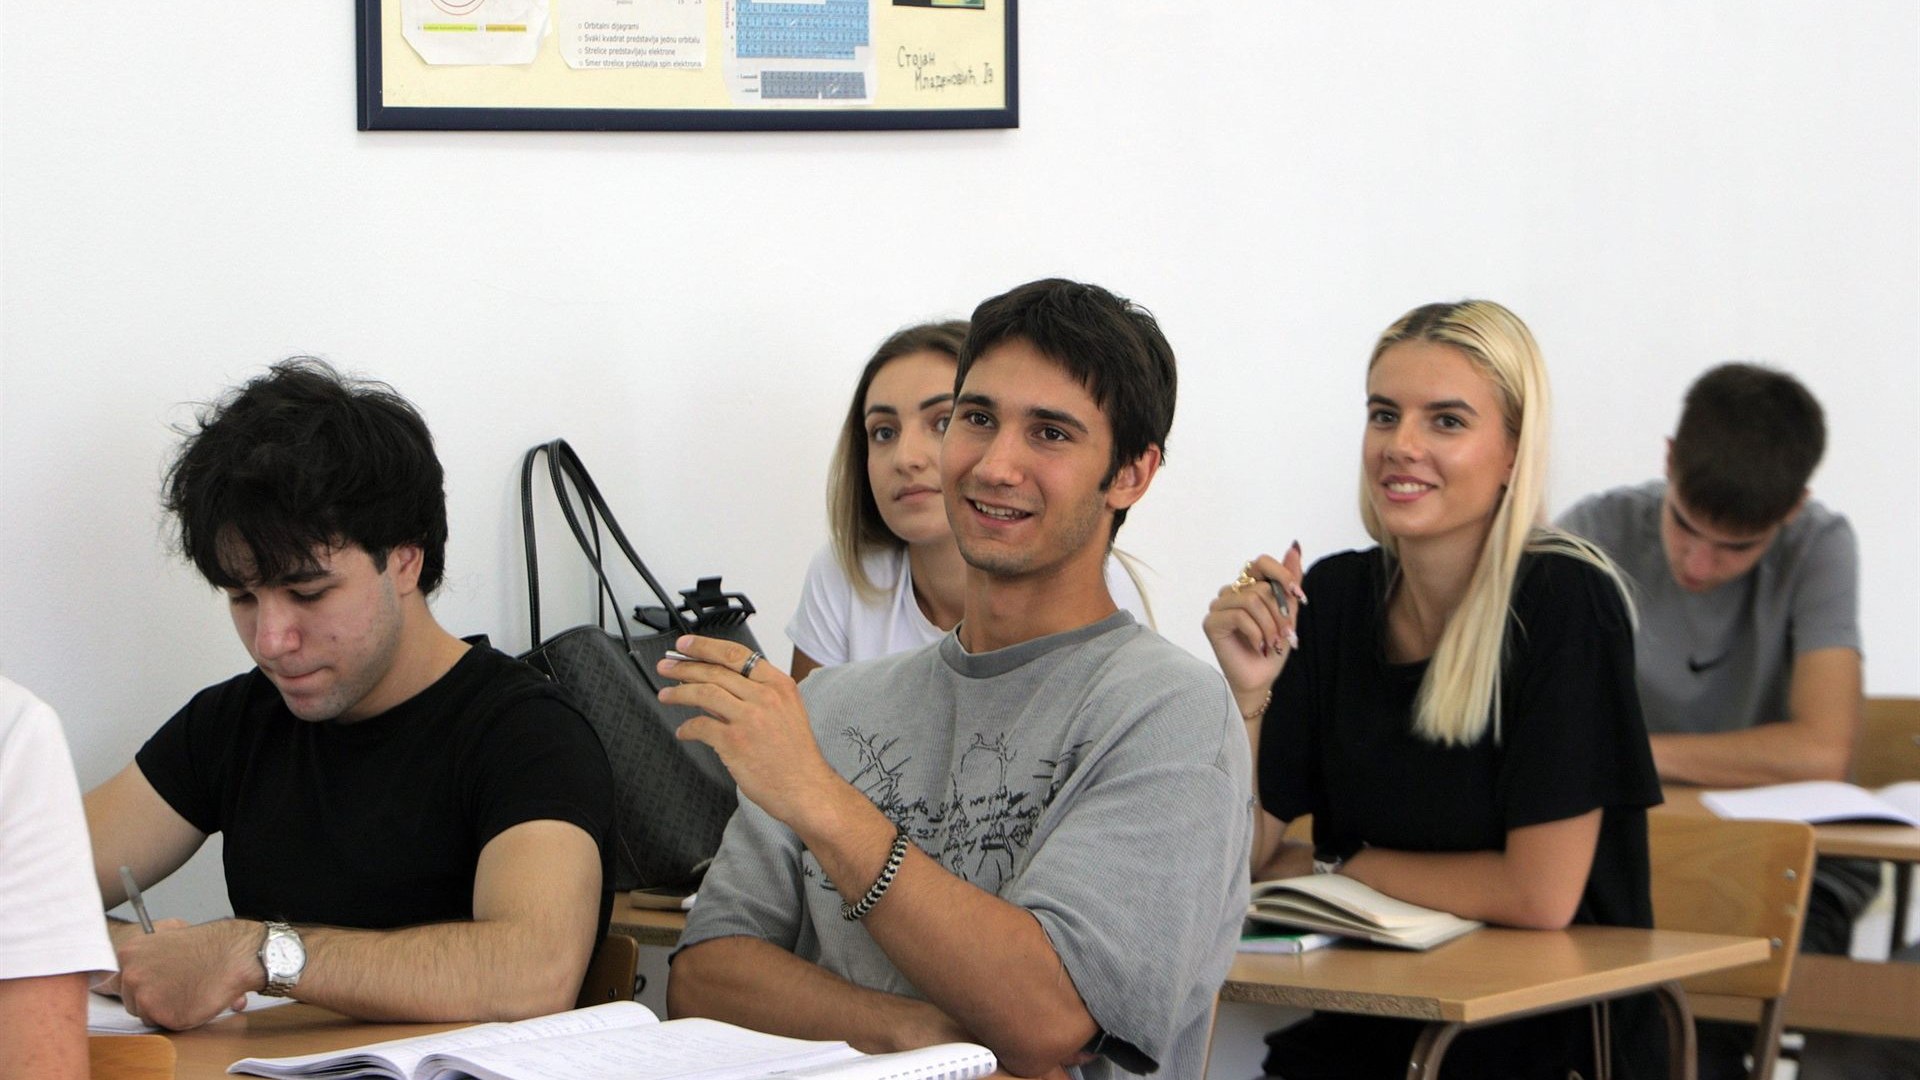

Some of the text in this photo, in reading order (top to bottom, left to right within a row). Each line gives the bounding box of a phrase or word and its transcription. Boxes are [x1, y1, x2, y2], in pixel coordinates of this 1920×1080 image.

[584, 22, 610, 30] Orbitalni
[584, 34, 601, 43] Svaki
[602, 34, 625, 43] kvadrat
[626, 35, 659, 45] predstavlja
[660, 36, 677, 45] jednu
[584, 46, 607, 55] Strelice
